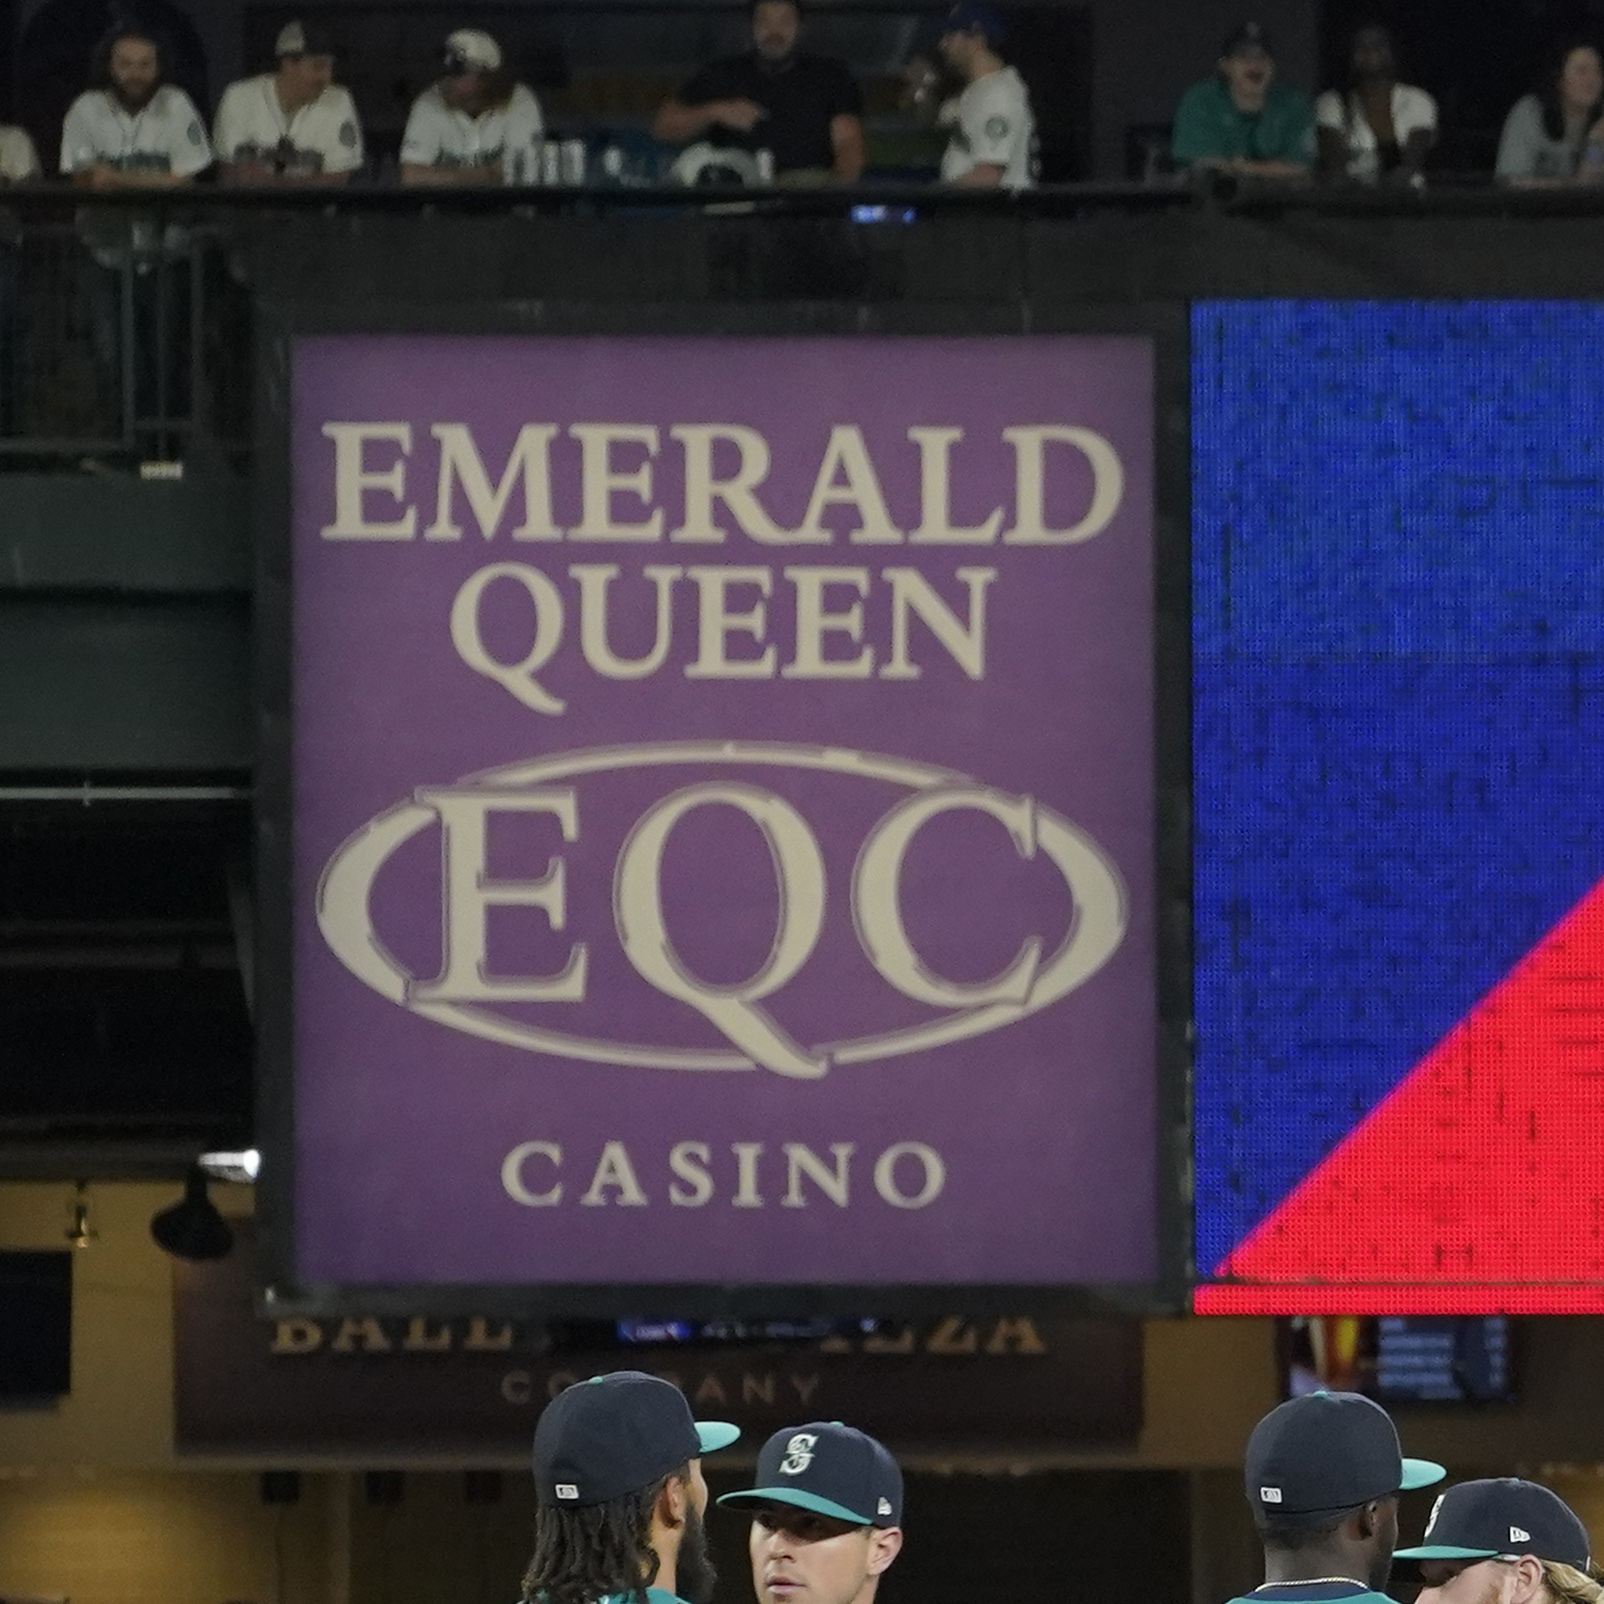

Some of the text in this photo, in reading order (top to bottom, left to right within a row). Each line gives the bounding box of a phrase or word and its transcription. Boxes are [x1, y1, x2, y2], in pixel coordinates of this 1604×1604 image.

[321, 421, 1125, 545] EMERALD
[450, 562, 996, 714] QUEEN
[405, 782, 1043, 1079] EQC
[501, 1141, 945, 1208] CASINO
